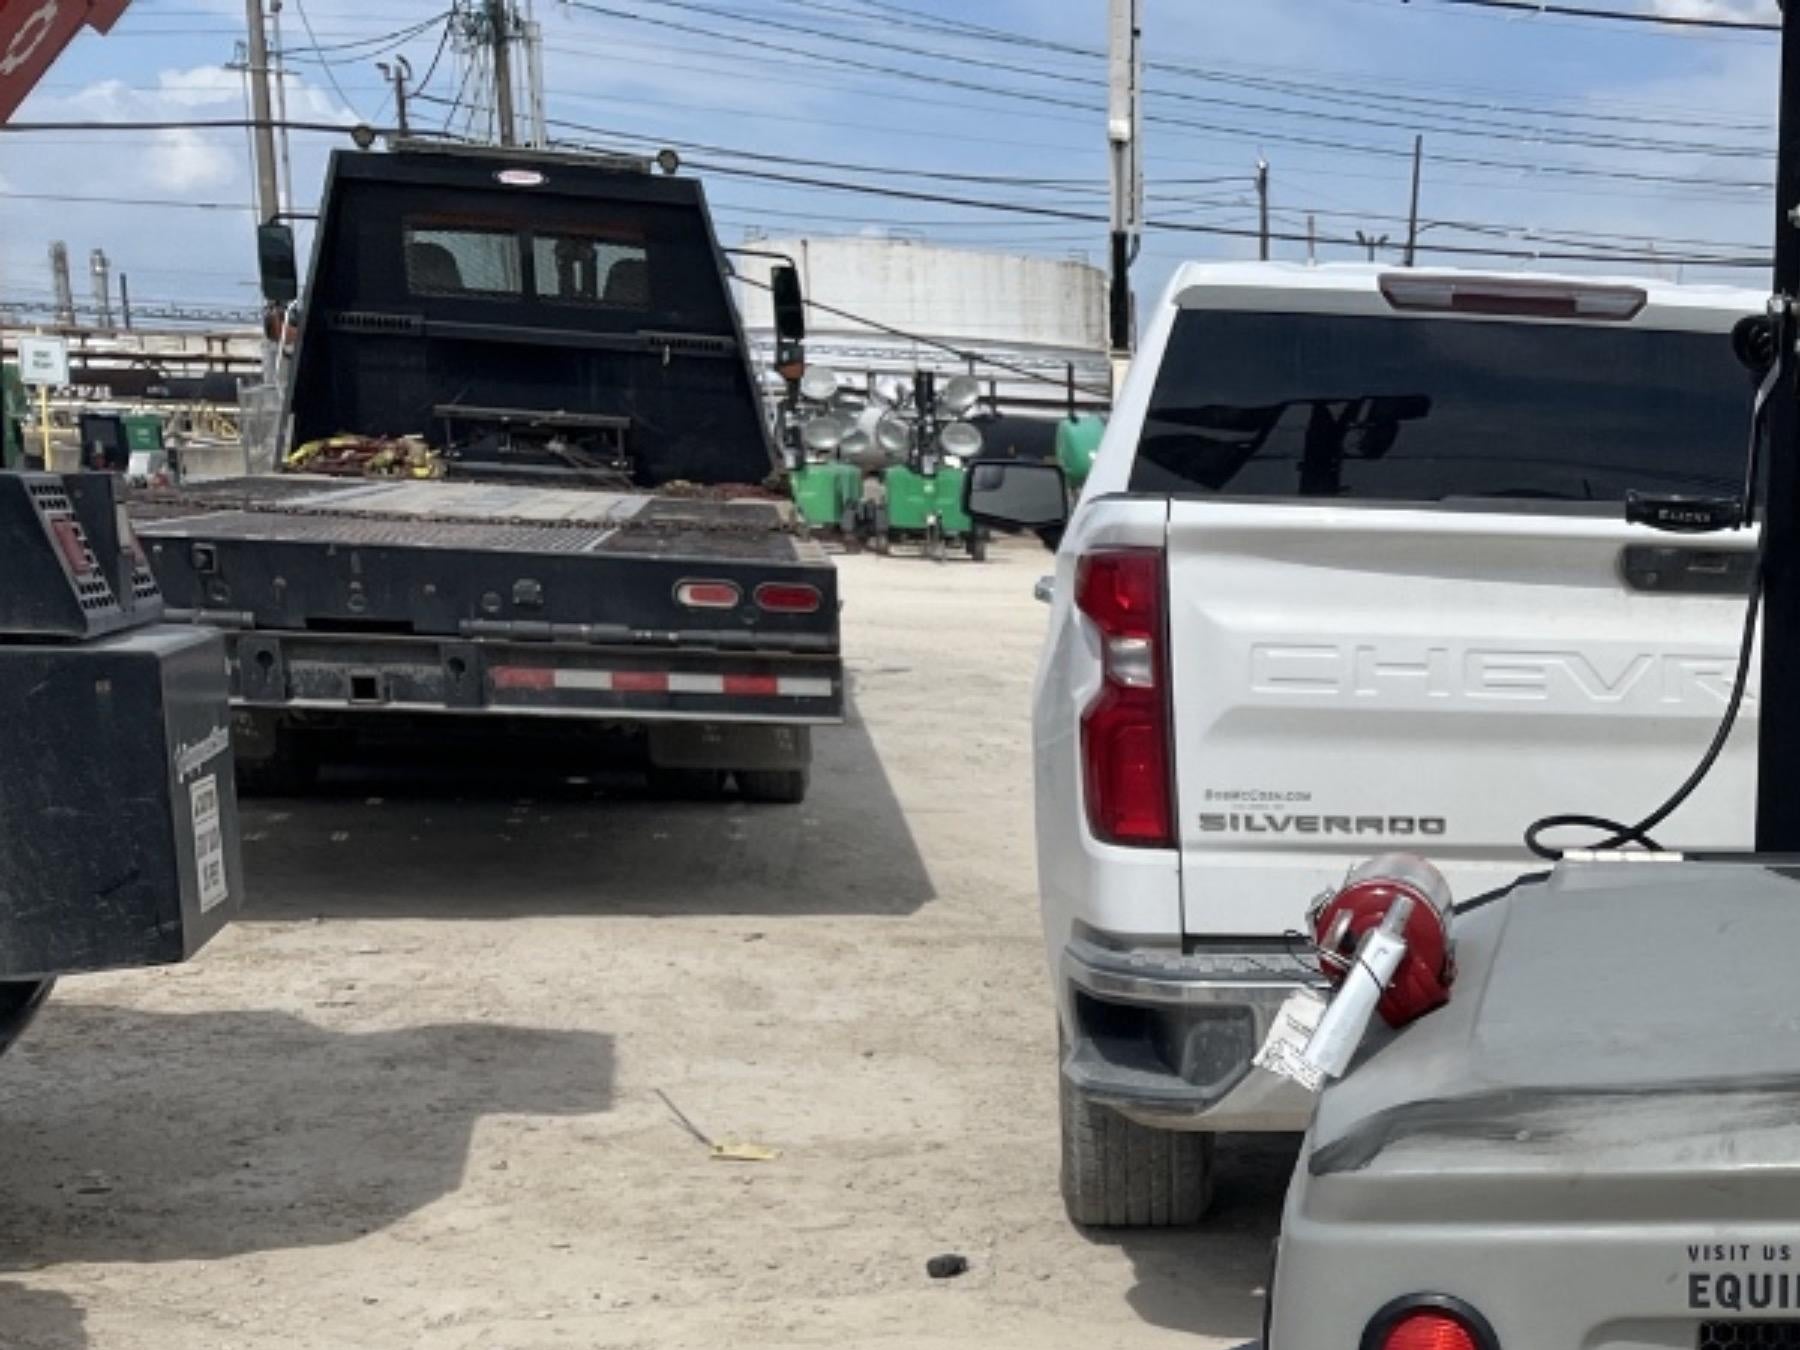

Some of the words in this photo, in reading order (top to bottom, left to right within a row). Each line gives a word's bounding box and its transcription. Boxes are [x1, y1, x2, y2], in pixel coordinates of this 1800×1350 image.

[1199, 812, 1446, 835] SILVERADO
[1687, 1244, 1750, 1262] VISIT
[1762, 1244, 1791, 1262] US
